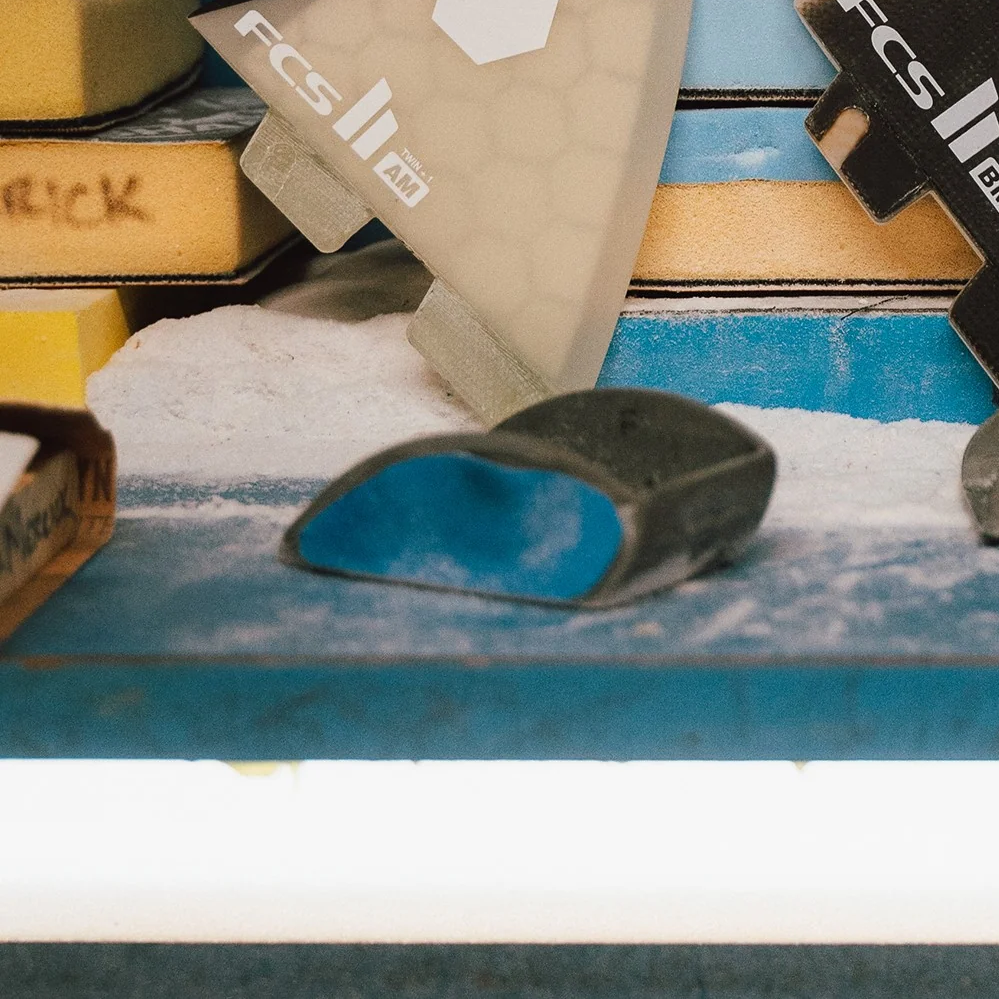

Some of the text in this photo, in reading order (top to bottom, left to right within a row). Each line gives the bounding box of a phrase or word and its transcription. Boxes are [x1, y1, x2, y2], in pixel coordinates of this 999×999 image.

[233, 9, 343, 116] FCS
[401, 147, 423, 173] TWIN
[383, 164, 421, 199] AM
